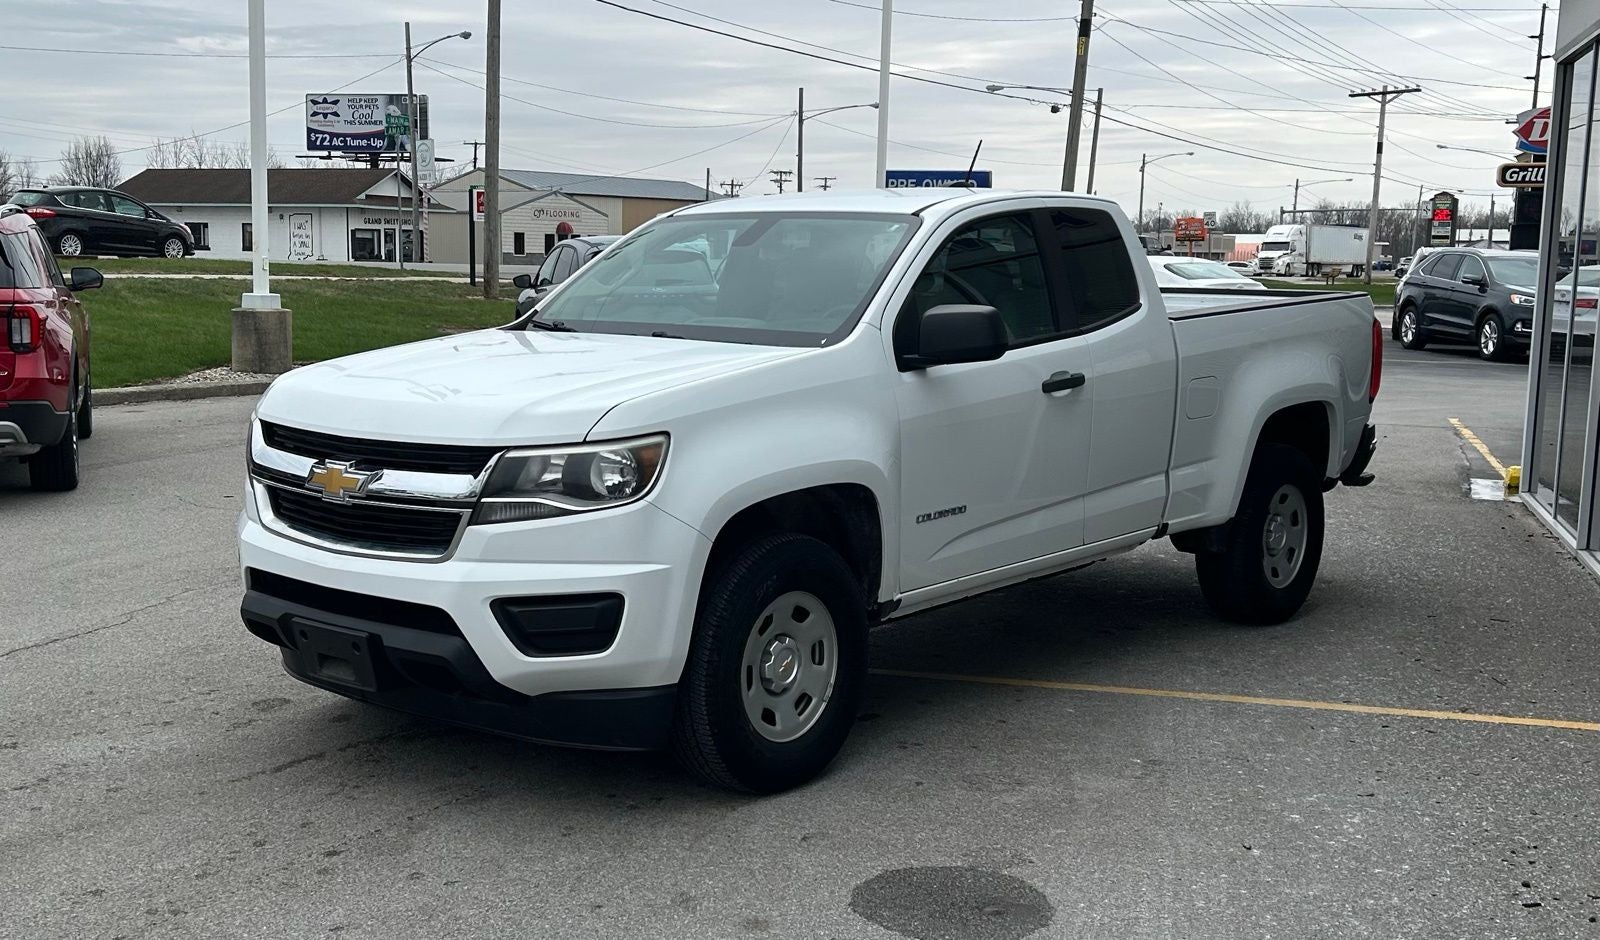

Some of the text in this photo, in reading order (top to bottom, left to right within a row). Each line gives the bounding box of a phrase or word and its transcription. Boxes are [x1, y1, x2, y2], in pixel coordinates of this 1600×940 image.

[352, 110, 373, 119] Cool
[385, 127, 405, 135] LAMAR
[311, 133, 383, 148] $72 AC Tune-Up
[1505, 167, 1544, 182] Grill
[888, 178, 977, 188] PRE-OWD
[546, 210, 580, 218] FLOORING
[297, 222, 306, 230] WAS
[298, 240, 310, 248] SMALL
[916, 505, 967, 524] COLORADO
